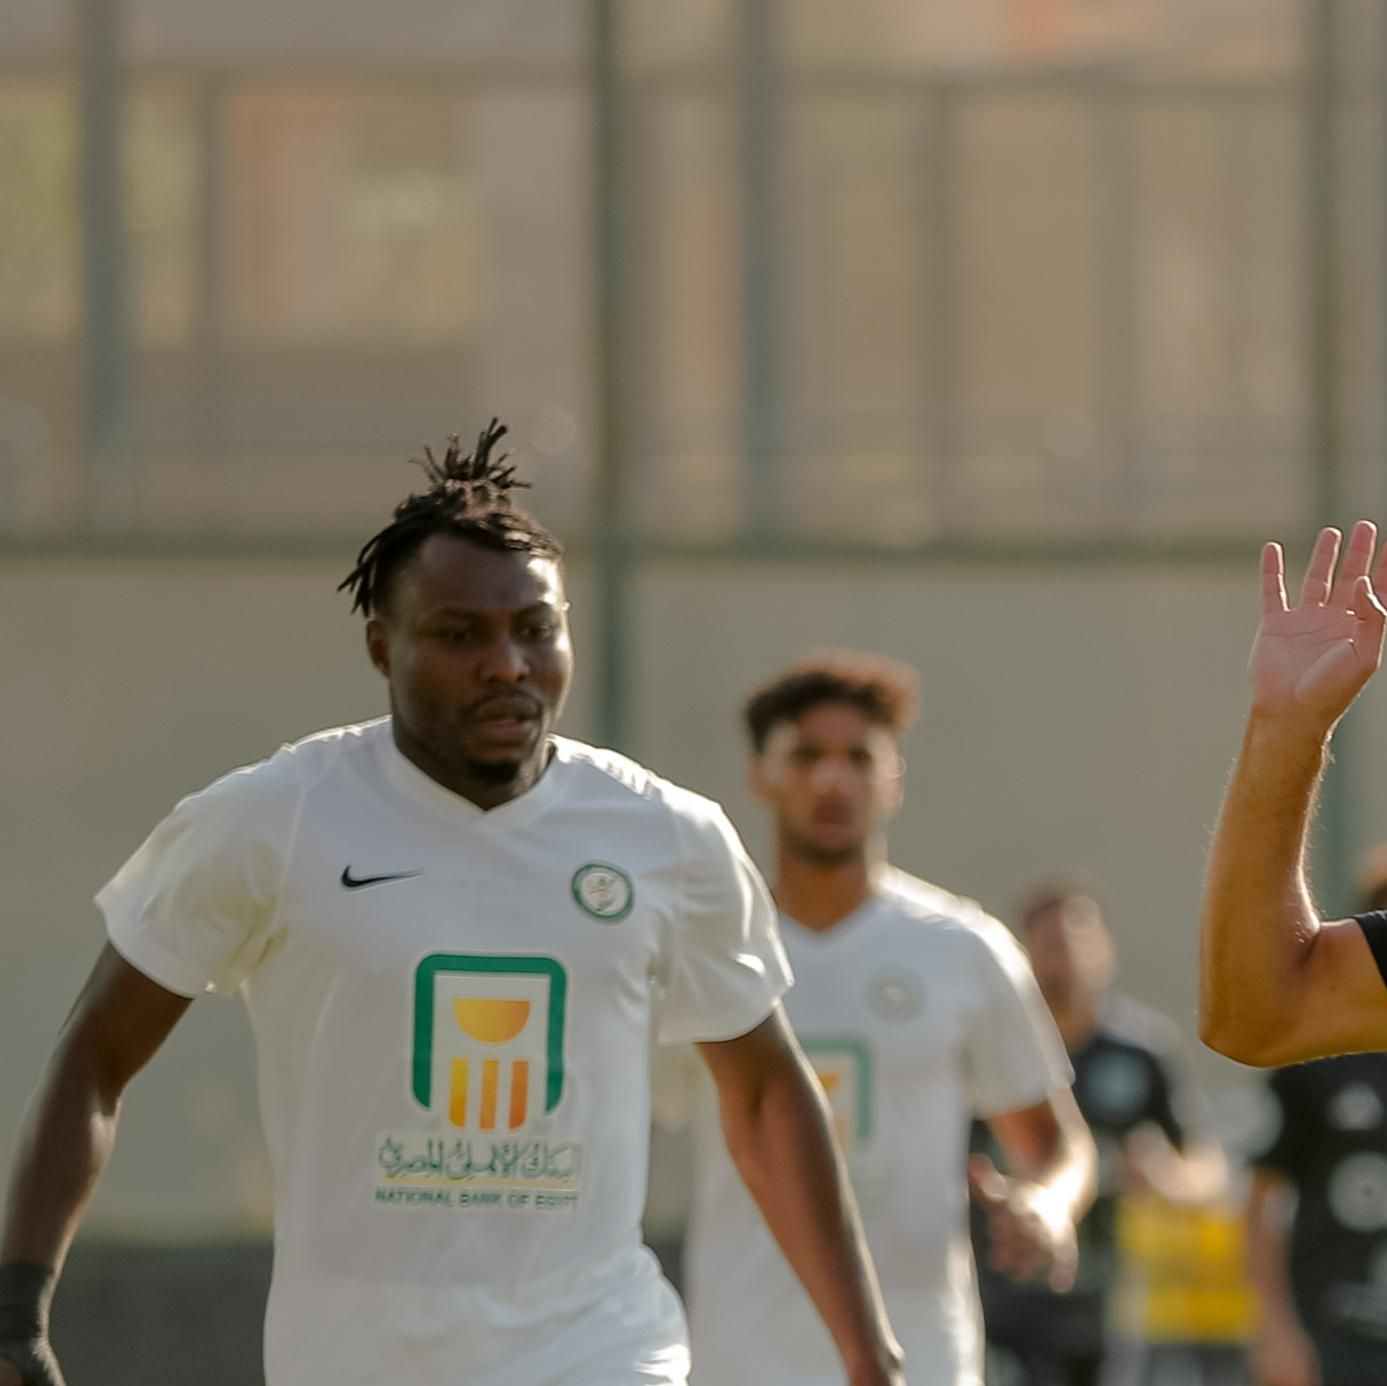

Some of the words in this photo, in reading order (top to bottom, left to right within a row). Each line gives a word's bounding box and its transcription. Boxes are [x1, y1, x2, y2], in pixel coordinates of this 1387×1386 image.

[375, 1188, 453, 1208] NATIONAL
[460, 1192, 502, 1208] BANK
[508, 1193, 530, 1207] OF
